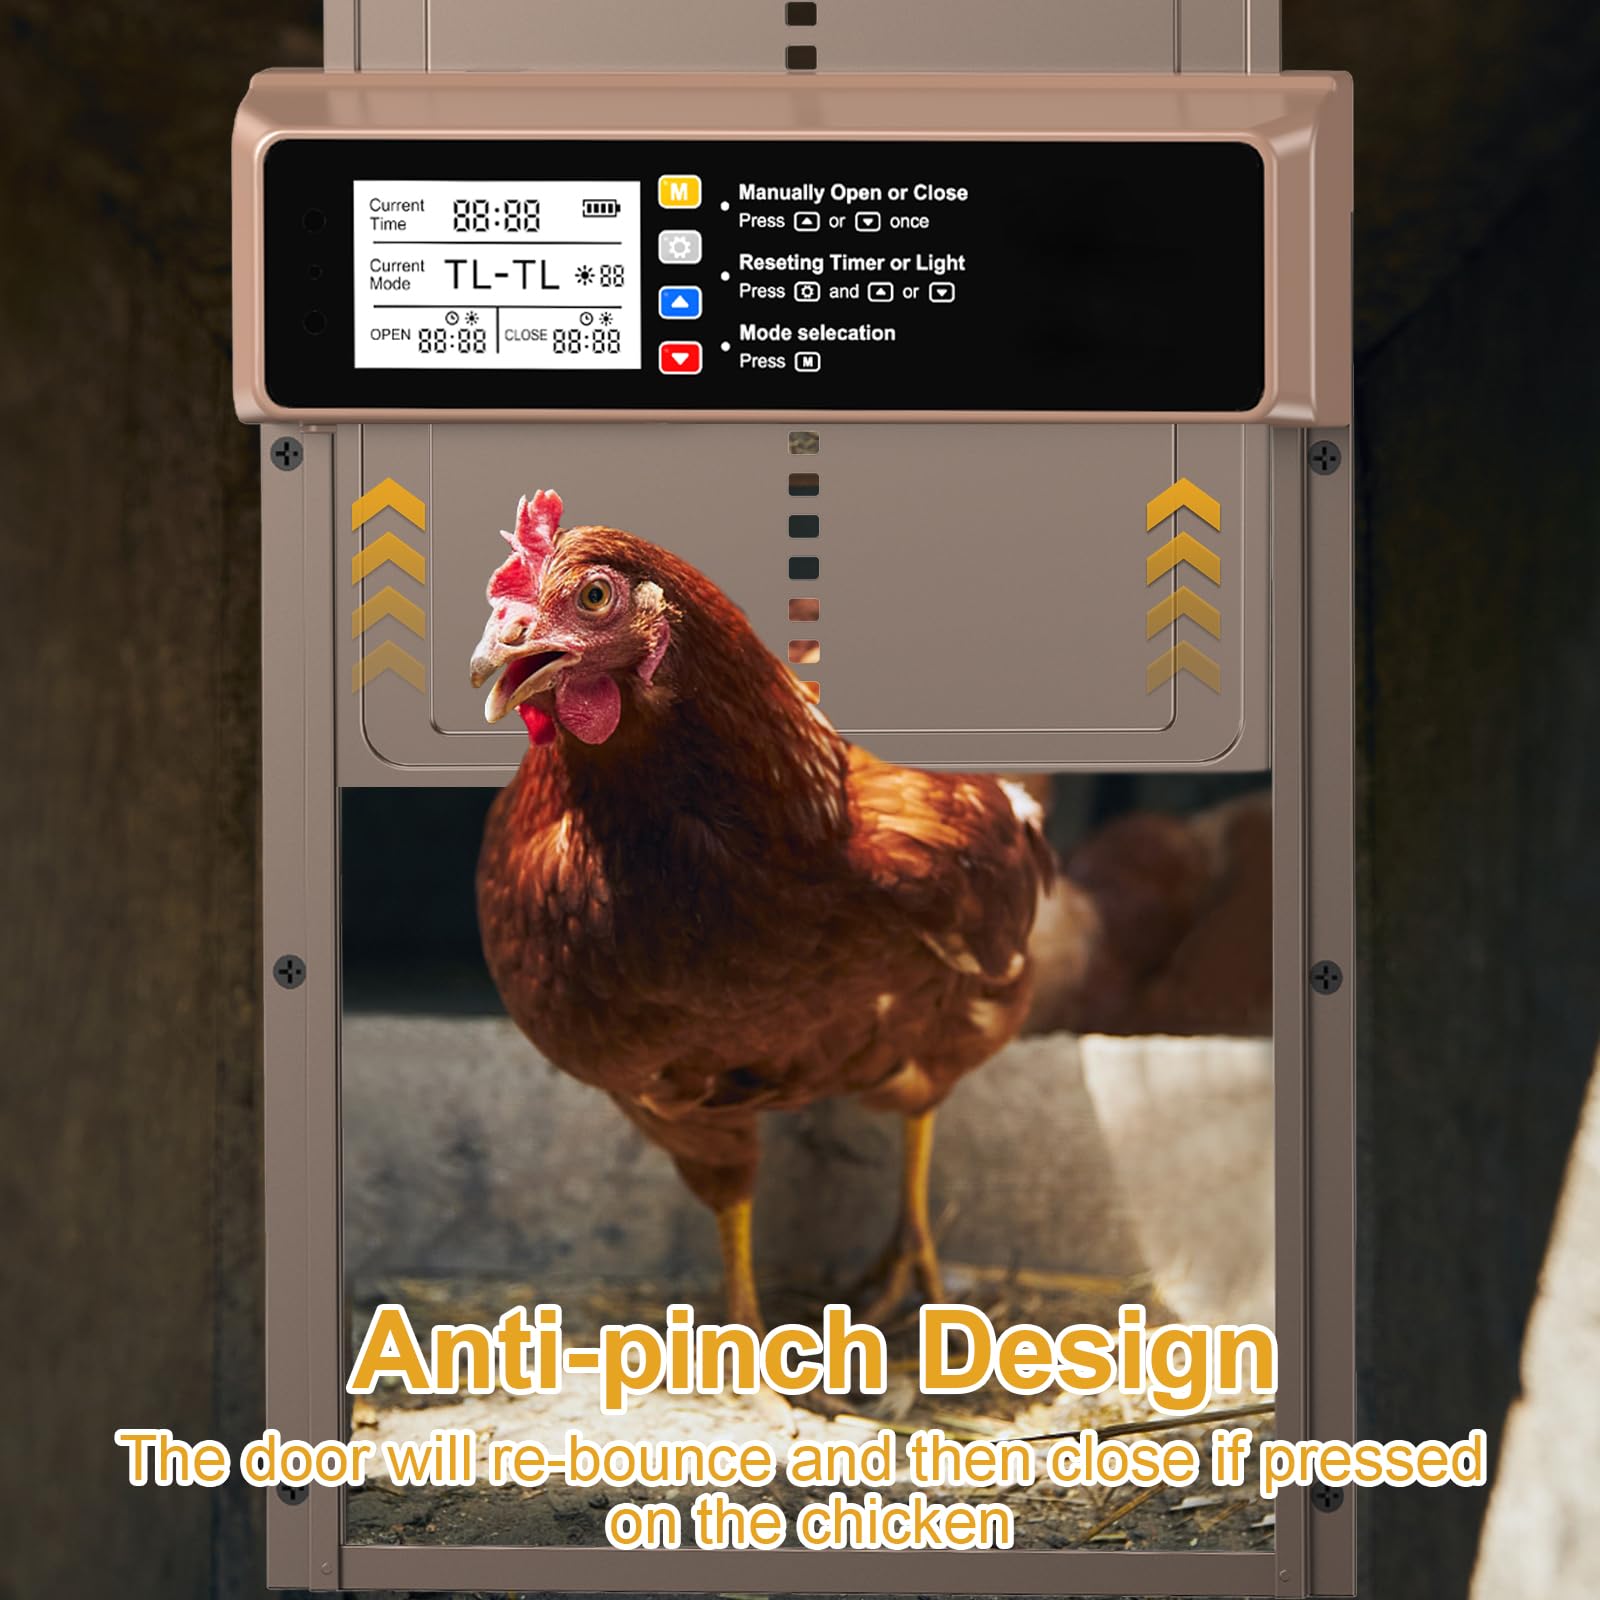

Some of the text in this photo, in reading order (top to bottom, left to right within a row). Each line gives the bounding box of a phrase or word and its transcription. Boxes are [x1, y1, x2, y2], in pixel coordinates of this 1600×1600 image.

[670, 183, 688, 200] M
[739, 183, 969, 204] Manually Open or Close
[369, 198, 425, 212] Current
[370, 217, 407, 231] Time
[453, 199, 540, 232] 88:88
[739, 213, 929, 228] Press or once
[369, 258, 425, 272] Current
[739, 254, 966, 275] Reseting Timer or Light
[444, 259, 560, 289] TL-TL
[600, 264, 624, 287] 88
[370, 277, 411, 290] Mode
[740, 283, 919, 298] Press and or
[370, 328, 486, 353] OPEN 88:88
[740, 324, 896, 341] Mode selecation
[504, 329, 620, 354] CLOSE 88:88
[740, 354, 786, 368] Press
